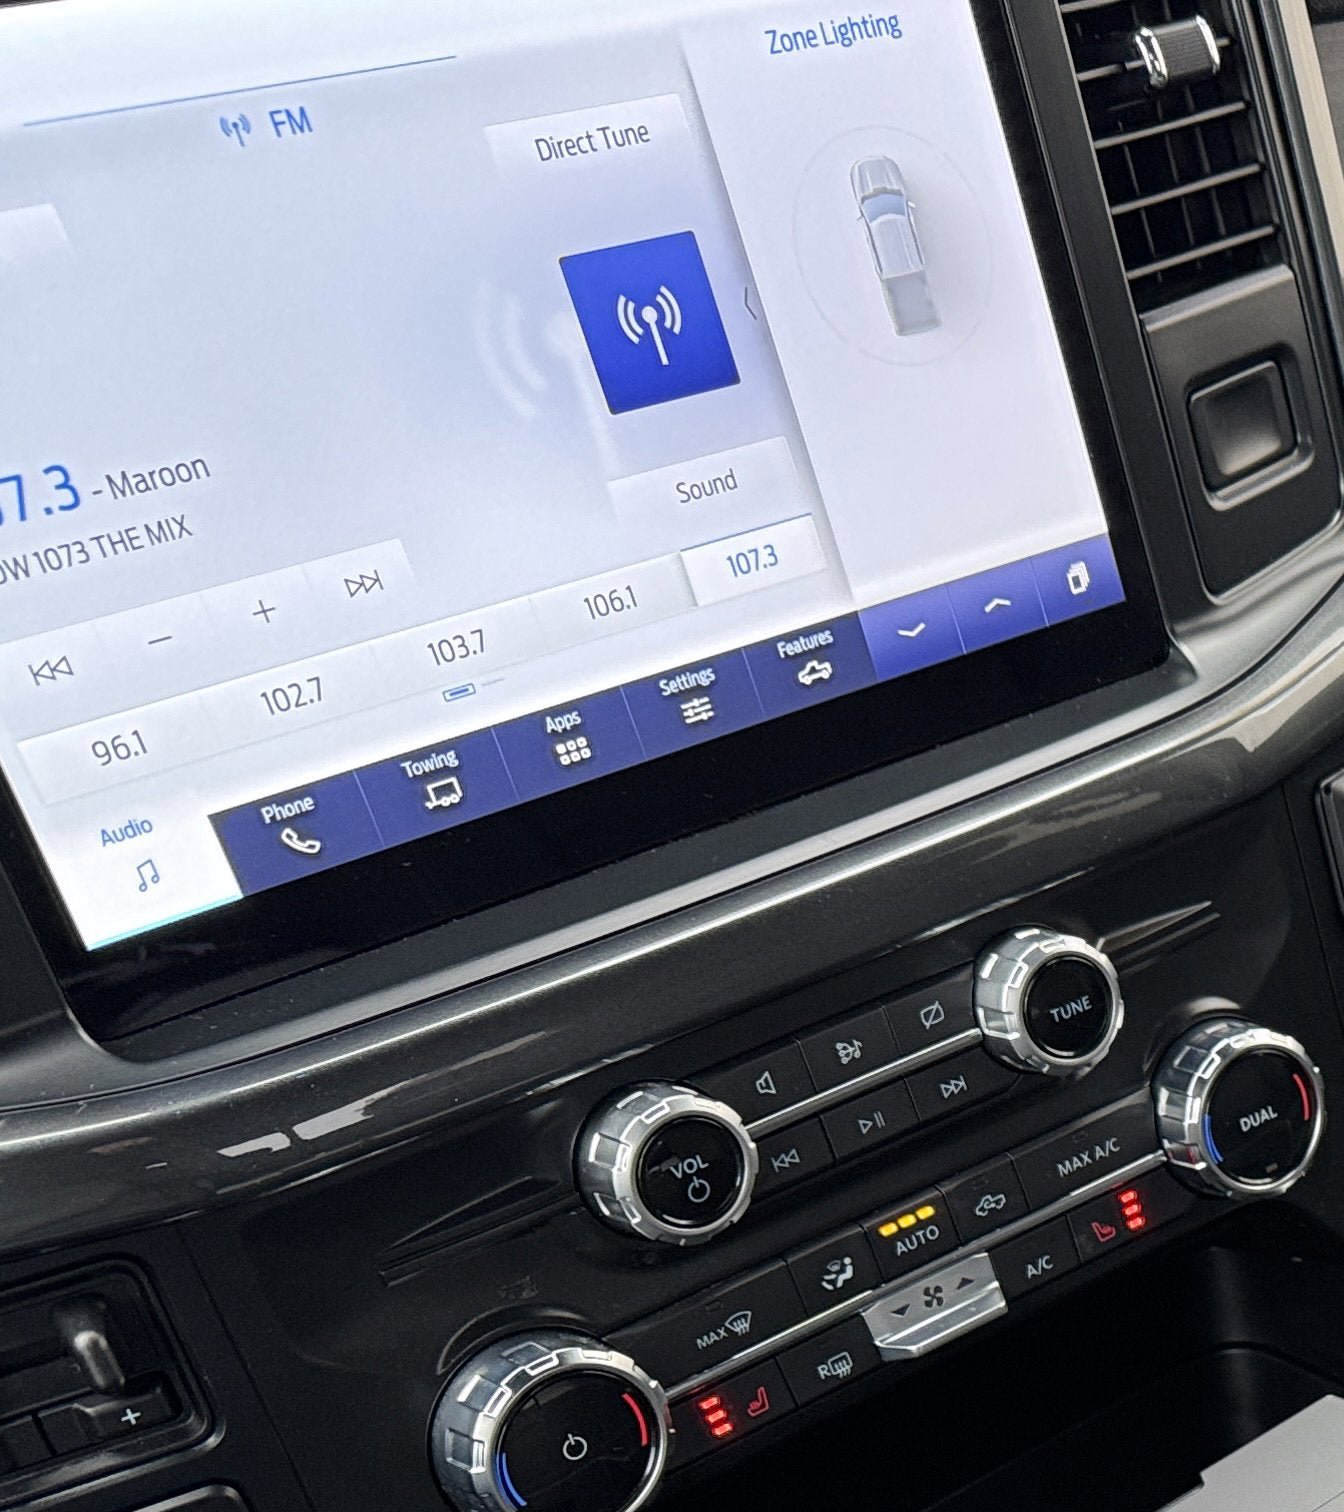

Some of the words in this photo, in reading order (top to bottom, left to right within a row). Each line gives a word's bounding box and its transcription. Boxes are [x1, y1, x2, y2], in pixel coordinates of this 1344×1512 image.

[764, 28, 819, 55] Zone
[822, 12, 902, 47] Lighting
[269, 106, 313, 138] FM
[534, 132, 598, 162] Direct
[598, 119, 650, 149] Tune
[0, 464, 81, 528] 7.3
[104, 457, 211, 500] Maroon
[676, 468, 738, 503] Sound
[32, 540, 91, 574] 1073
[89, 526, 145, 558] THE
[144, 514, 194, 547] MIX
[726, 543, 779, 578] 107.3
[583, 585, 639, 620] 106.1
[426, 628, 486, 666] 103.7
[776, 629, 834, 658] Features
[259, 676, 325, 716] 102.7
[659, 666, 716, 697] Settings
[544, 709, 582, 734] Apps
[90, 729, 149, 766] 96.1
[400, 748, 460, 779] Towing
[260, 794, 316, 824] Phone
[99, 816, 154, 847] Audio
[1050, 995, 1093, 1023] TUNE
[1239, 1105, 1279, 1132] DUAL
[669, 1154, 709, 1179] VOL
[1056, 1151, 1092, 1178] MAX
[1095, 1137, 1121, 1159] A/C
[895, 1225, 940, 1256] AUTO
[1026, 1255, 1054, 1279] A/C
[696, 1325, 729, 1350] MAX
